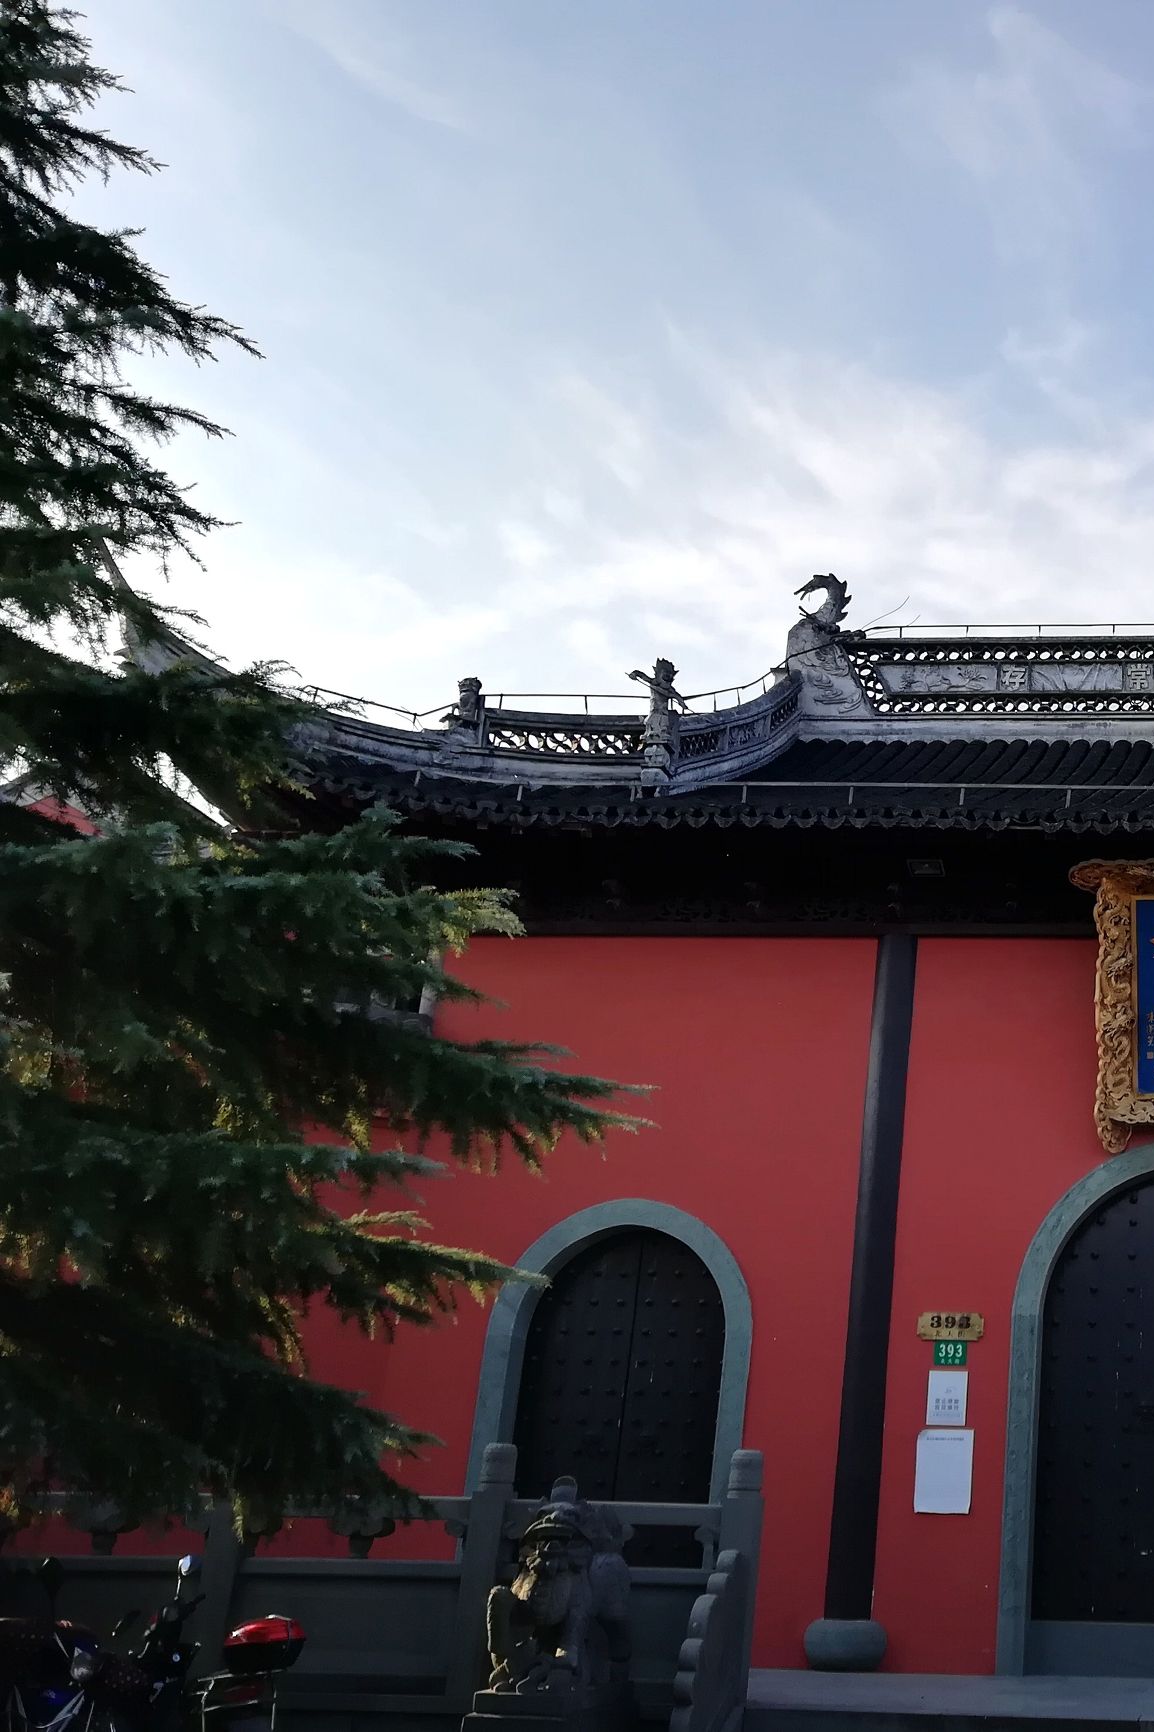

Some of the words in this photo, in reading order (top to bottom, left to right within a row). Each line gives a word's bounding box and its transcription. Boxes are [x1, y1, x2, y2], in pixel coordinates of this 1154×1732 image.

[1002, 665, 1027, 692] 存
[1127, 664, 1151, 690] 常
[930, 1315, 971, 1329] 393
[938, 1343, 963, 1358] 393
